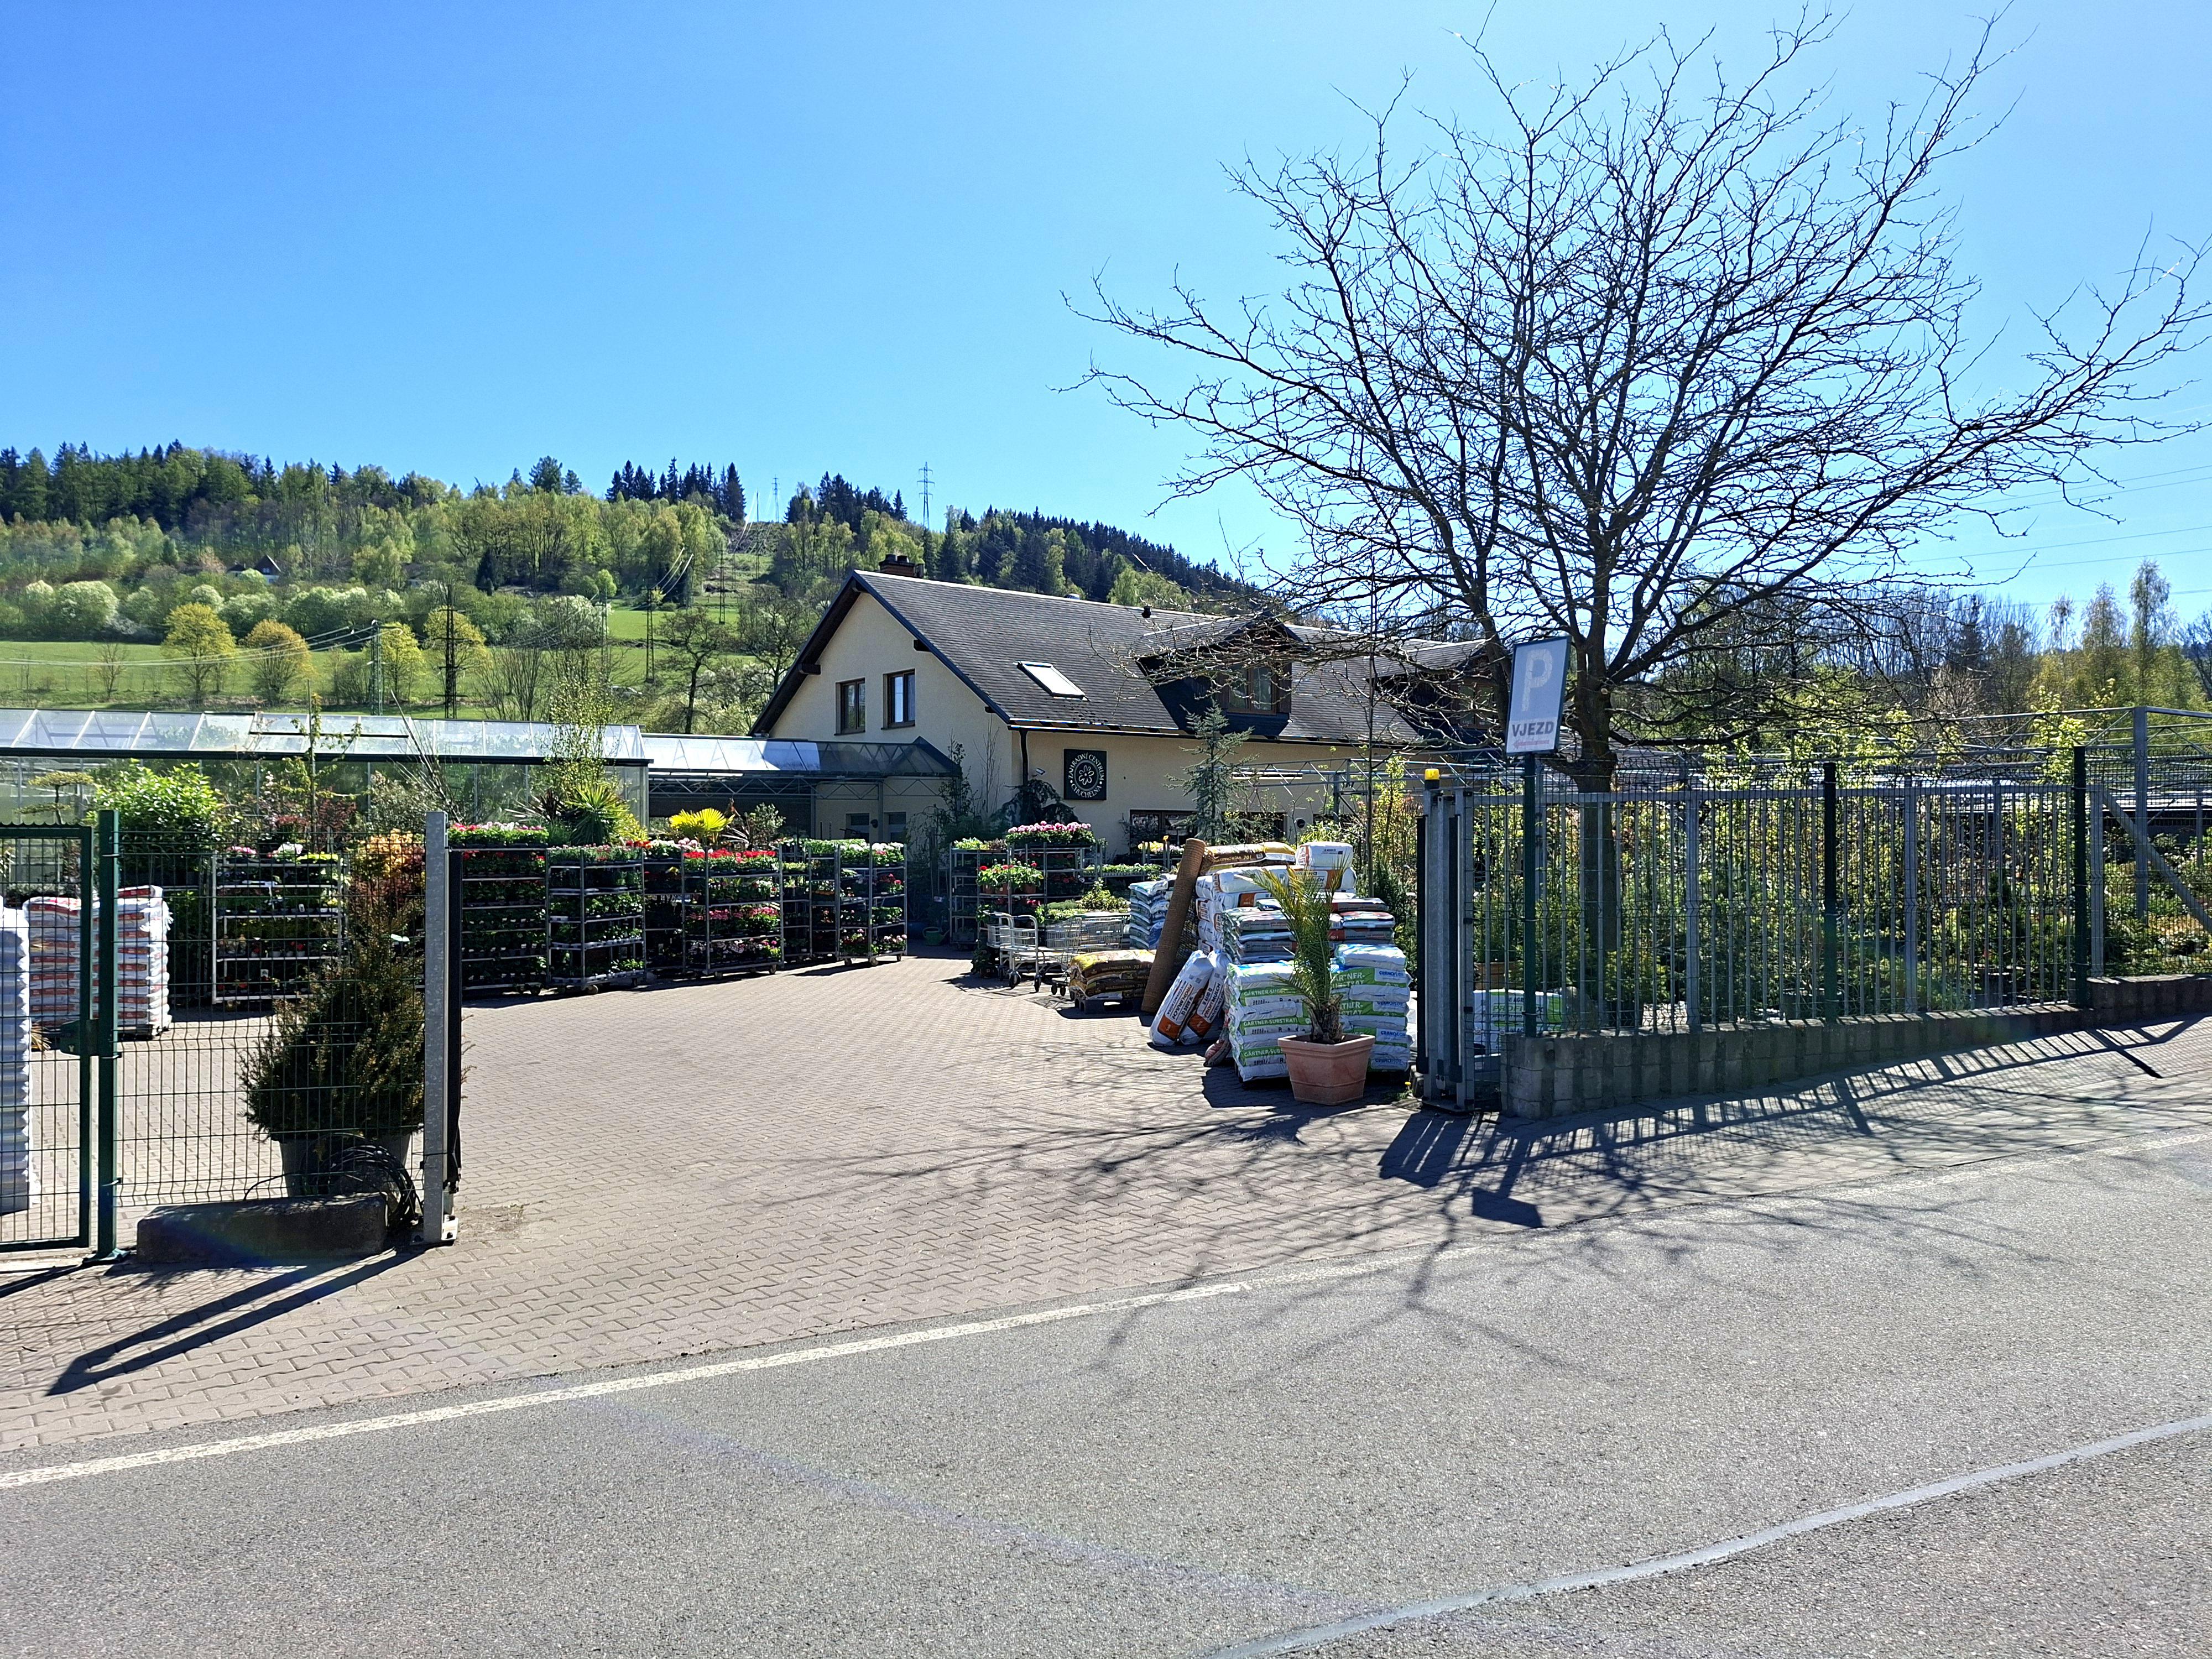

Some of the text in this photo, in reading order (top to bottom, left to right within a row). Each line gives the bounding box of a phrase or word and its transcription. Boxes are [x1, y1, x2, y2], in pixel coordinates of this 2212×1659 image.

[1522, 649, 1552, 711] P
[1512, 721, 1554, 737] VJEZD
[1088, 754, 1104, 780] CENTRUM
